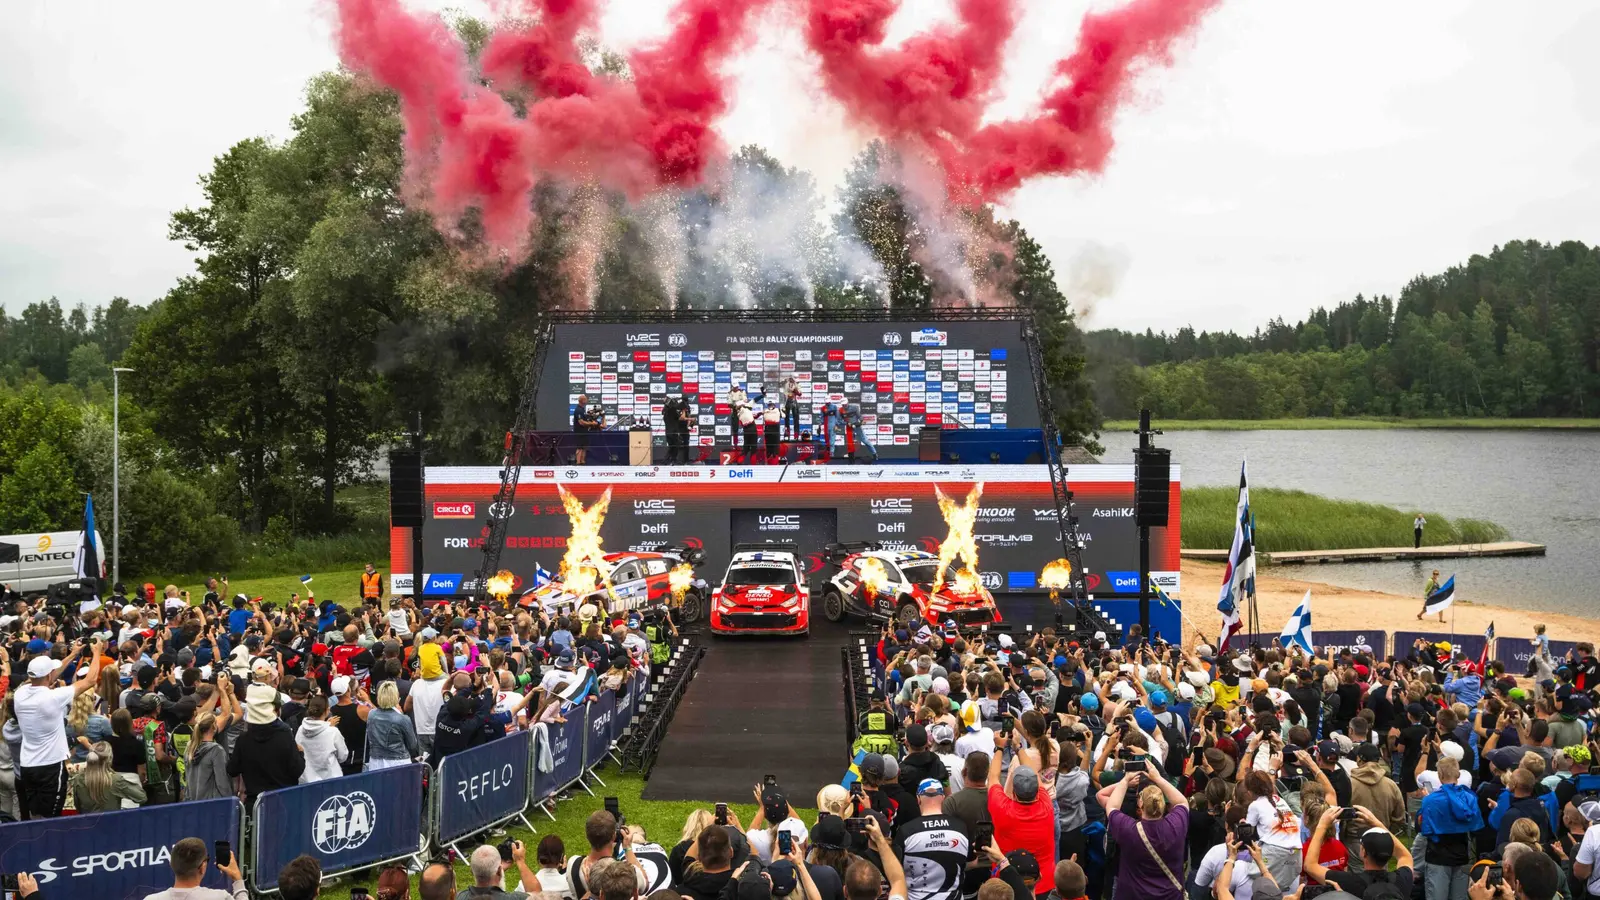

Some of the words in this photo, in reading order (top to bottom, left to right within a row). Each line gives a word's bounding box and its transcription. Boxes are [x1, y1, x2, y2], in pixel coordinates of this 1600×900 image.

[626, 333, 660, 341] WRC
[766, 335, 788, 343] RALLY
[789, 335, 843, 343] CHAMPIONSHIP
[722, 454, 731, 465] 2
[729, 470, 753, 478] Delfi
[634, 500, 676, 508] WRC
[870, 498, 912, 508] WRC
[975, 508, 1016, 516] NKOOK
[1092, 508, 1134, 518] AsahiKA
[758, 515, 800, 524] WRC
[641, 524, 668, 534] Delfi
[878, 522, 906, 532] Delfi
[432, 580, 454, 588] Delfi
[1116, 578, 1138, 586] Delfi
[878, 600, 890, 609] CCI
[869, 744, 888, 754] 112
[458, 763, 513, 803] REFLO
[922, 820, 950, 828] TEAM
[72, 844, 176, 877] SPORTLA
